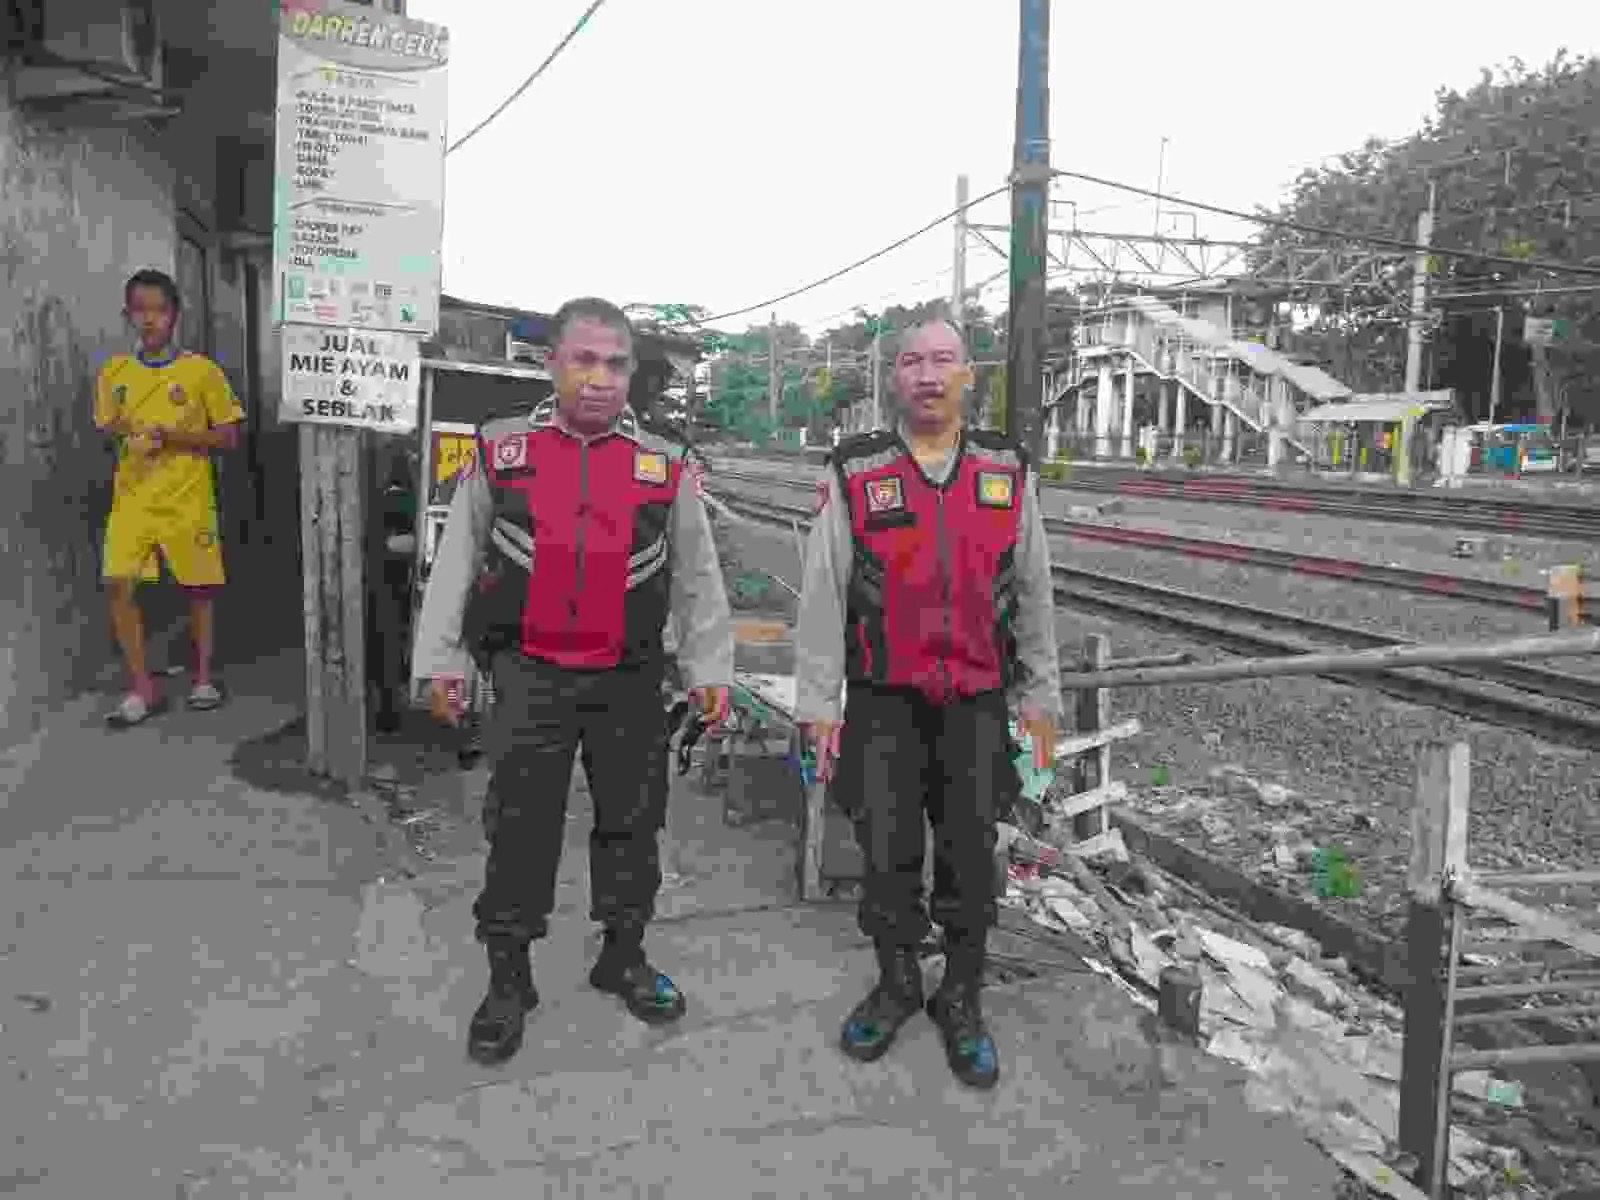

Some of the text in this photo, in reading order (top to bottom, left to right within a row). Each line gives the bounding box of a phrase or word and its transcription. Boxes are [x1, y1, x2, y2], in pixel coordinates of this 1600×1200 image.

[320, 334, 380, 356] JUAL
[289, 353, 409, 381] MIE AYAM
[340, 379, 358, 396] &
[303, 398, 396, 422] SEBLAK
